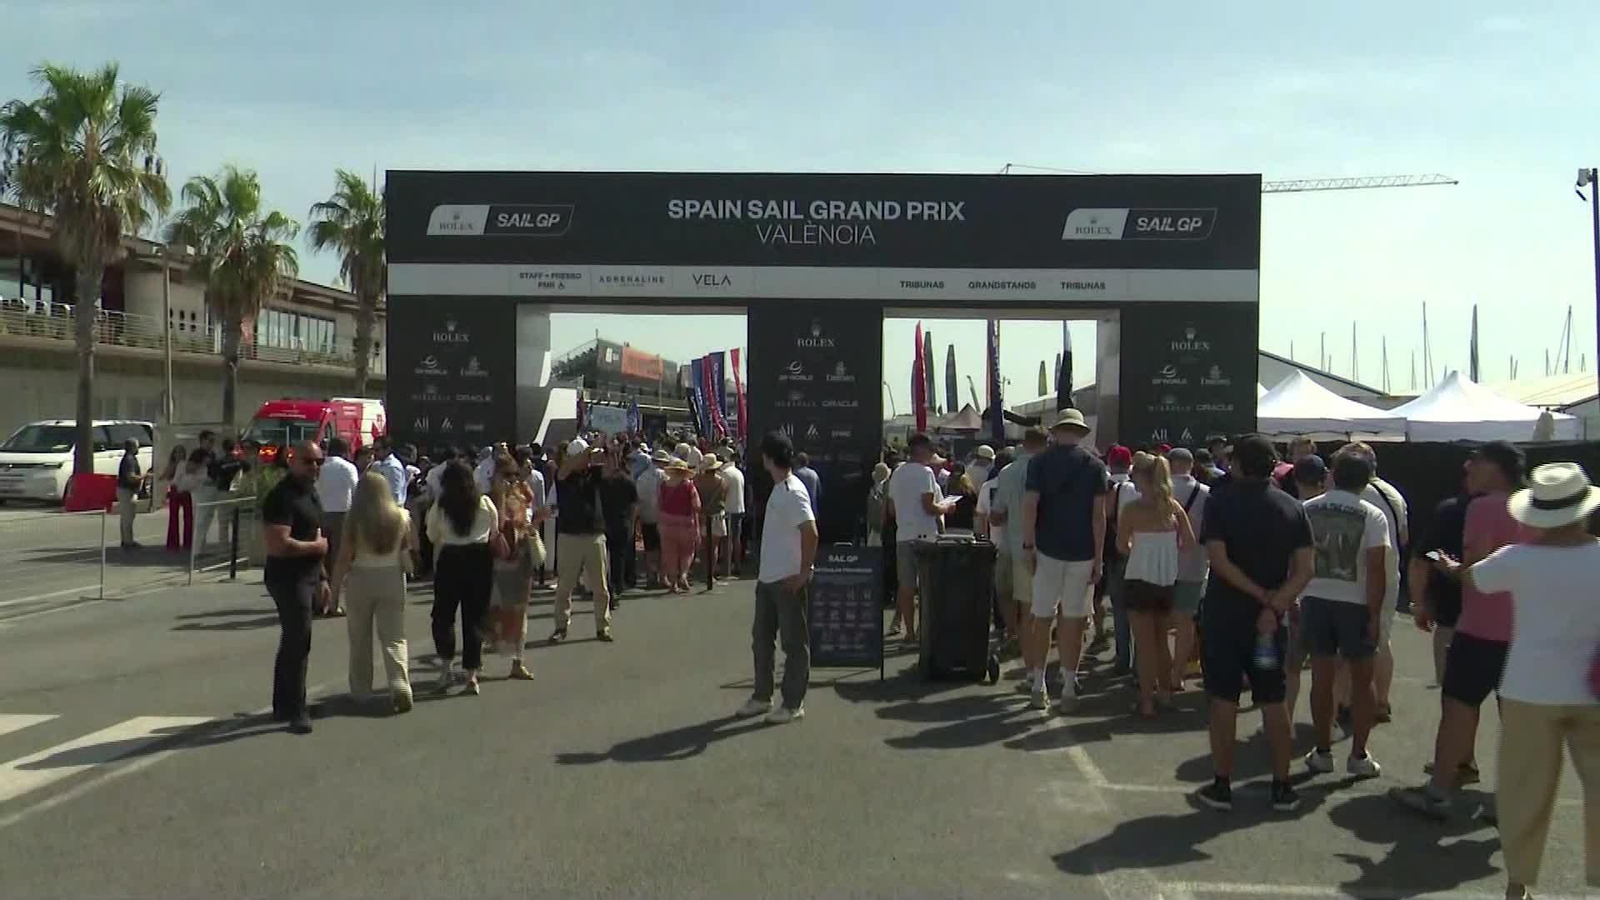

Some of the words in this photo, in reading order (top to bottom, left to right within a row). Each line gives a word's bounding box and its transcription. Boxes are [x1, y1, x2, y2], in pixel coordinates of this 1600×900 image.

[667, 199, 742, 219] SPAIN
[747, 199, 804, 219] SAIL
[808, 200, 901, 220] GRAND
[906, 200, 965, 221] PRIX
[756, 220, 877, 245] VALÈNCIA
[599, 274, 666, 284] ADRENALINE
[692, 273, 732, 286] VELA
[899, 280, 945, 290] TRIBUNAS
[967, 280, 1037, 290] GRANDSTANDS
[1060, 281, 1106, 291] TRIBUNAS
[797, 338, 835, 347] ROLEX
